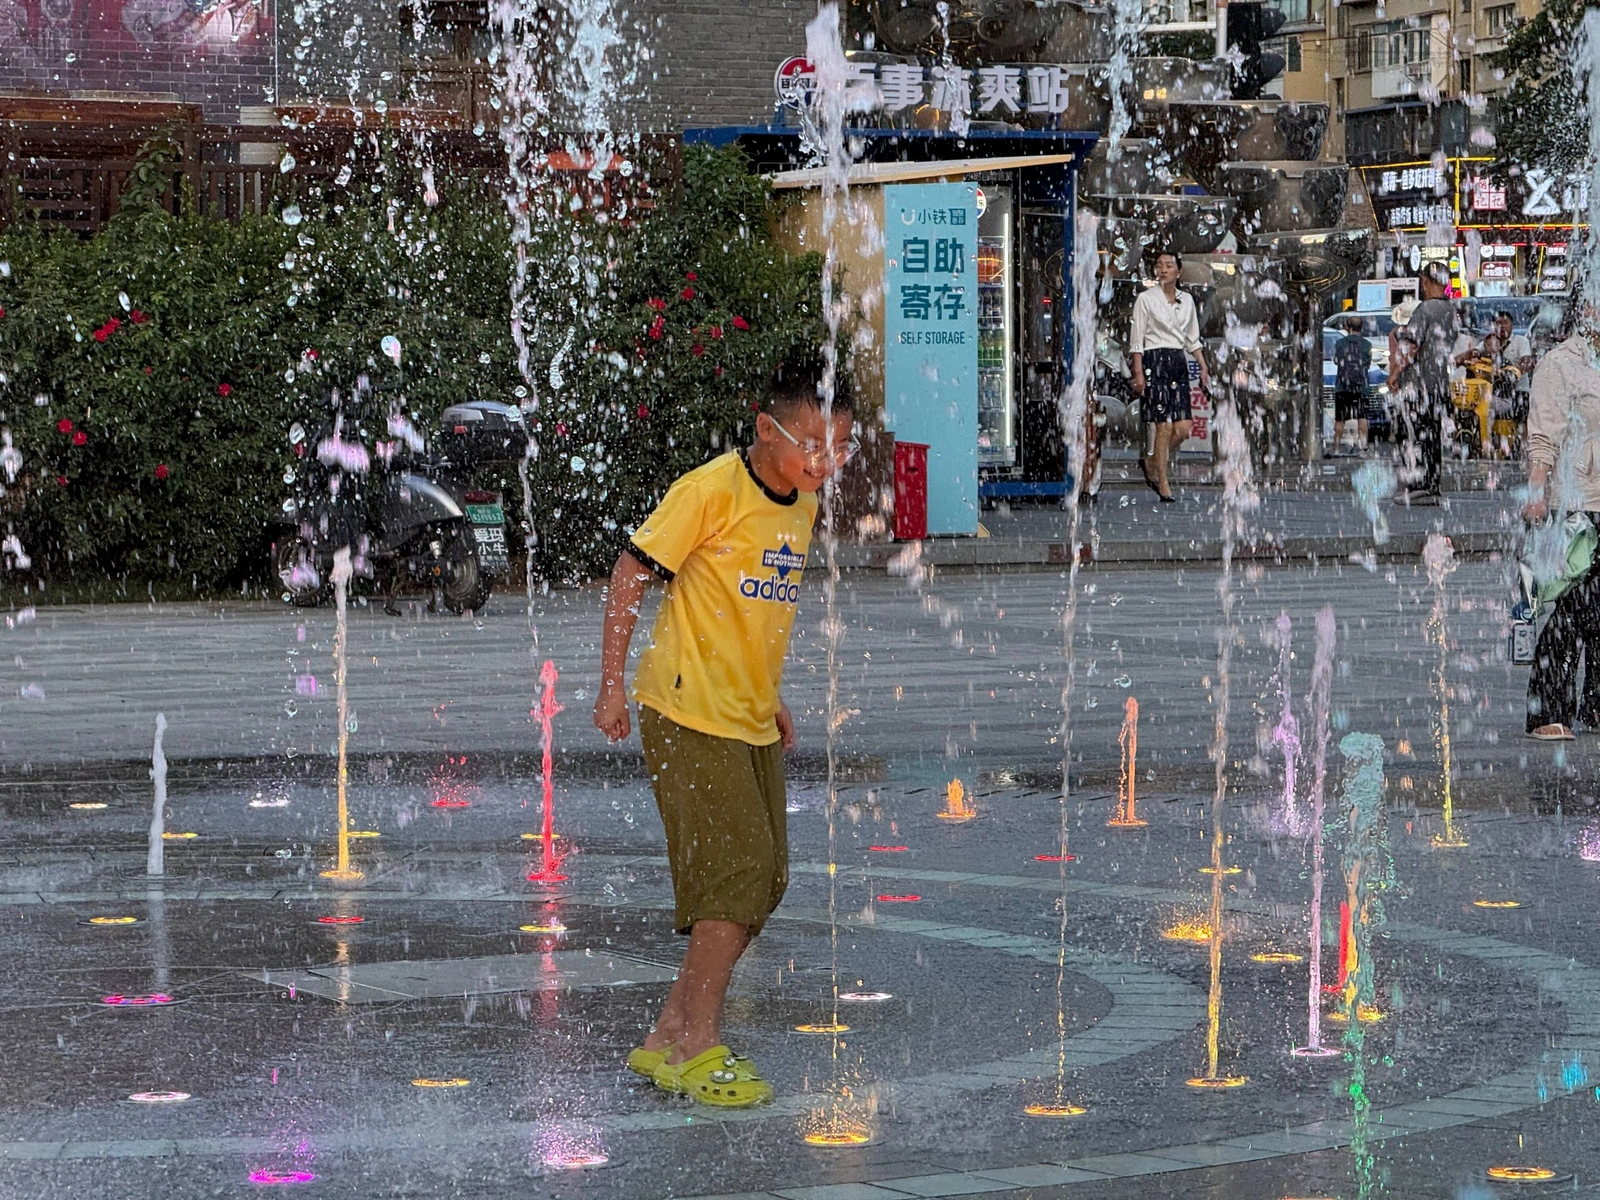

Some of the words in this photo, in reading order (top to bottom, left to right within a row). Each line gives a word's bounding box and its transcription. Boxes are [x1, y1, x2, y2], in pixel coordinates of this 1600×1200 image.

[902, 237, 965, 273] 自助
[900, 284, 965, 320] 寄存
[900, 331, 922, 344] SELF
[925, 331, 965, 344] STORAGE
[478, 542, 506, 555] 小牛
[765, 551, 803, 562] IMPOSSIBLE
[739, 575, 801, 603] adida
